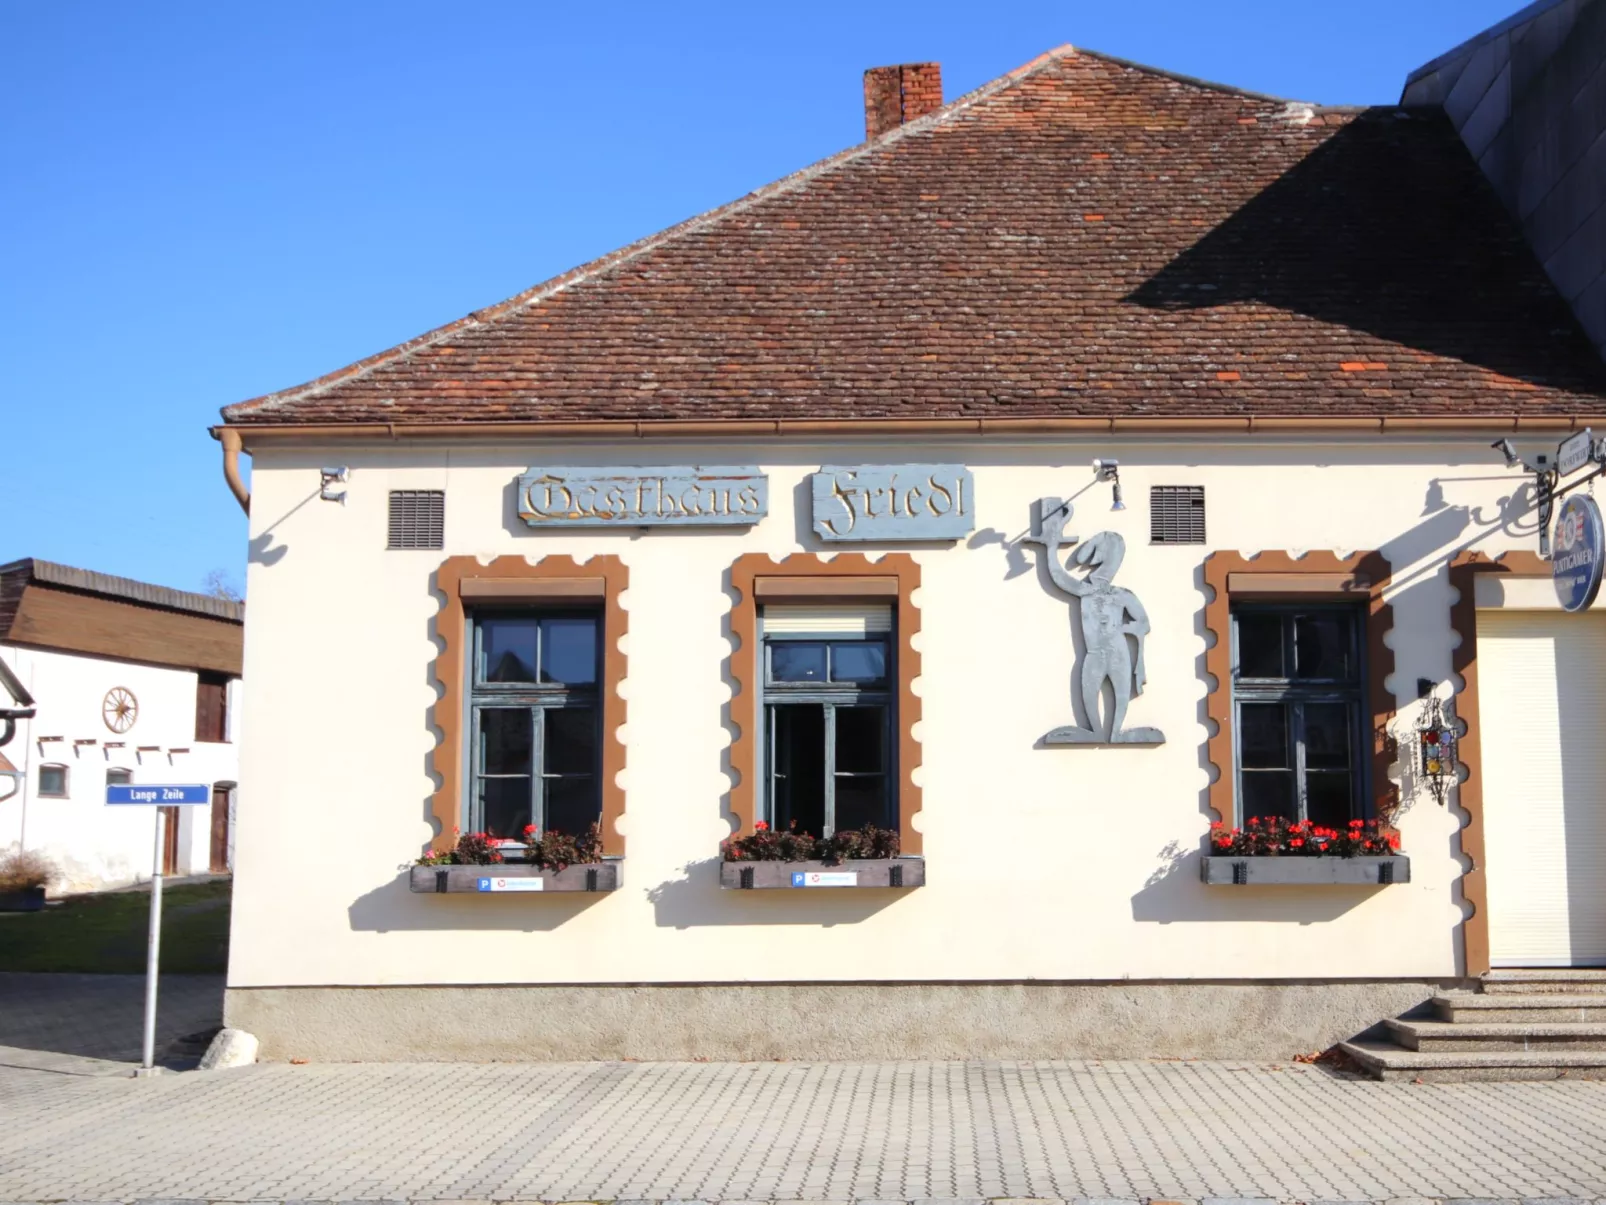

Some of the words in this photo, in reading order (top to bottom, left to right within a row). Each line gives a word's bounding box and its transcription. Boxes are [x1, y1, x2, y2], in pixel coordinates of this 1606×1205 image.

[523, 475, 760, 518] Gasthaus
[820, 471, 967, 535] Friedl
[130, 789, 157, 802] Lange
[162, 788, 185, 800] Zeile
[481, 879, 489, 889] P
[795, 874, 803, 885] P
